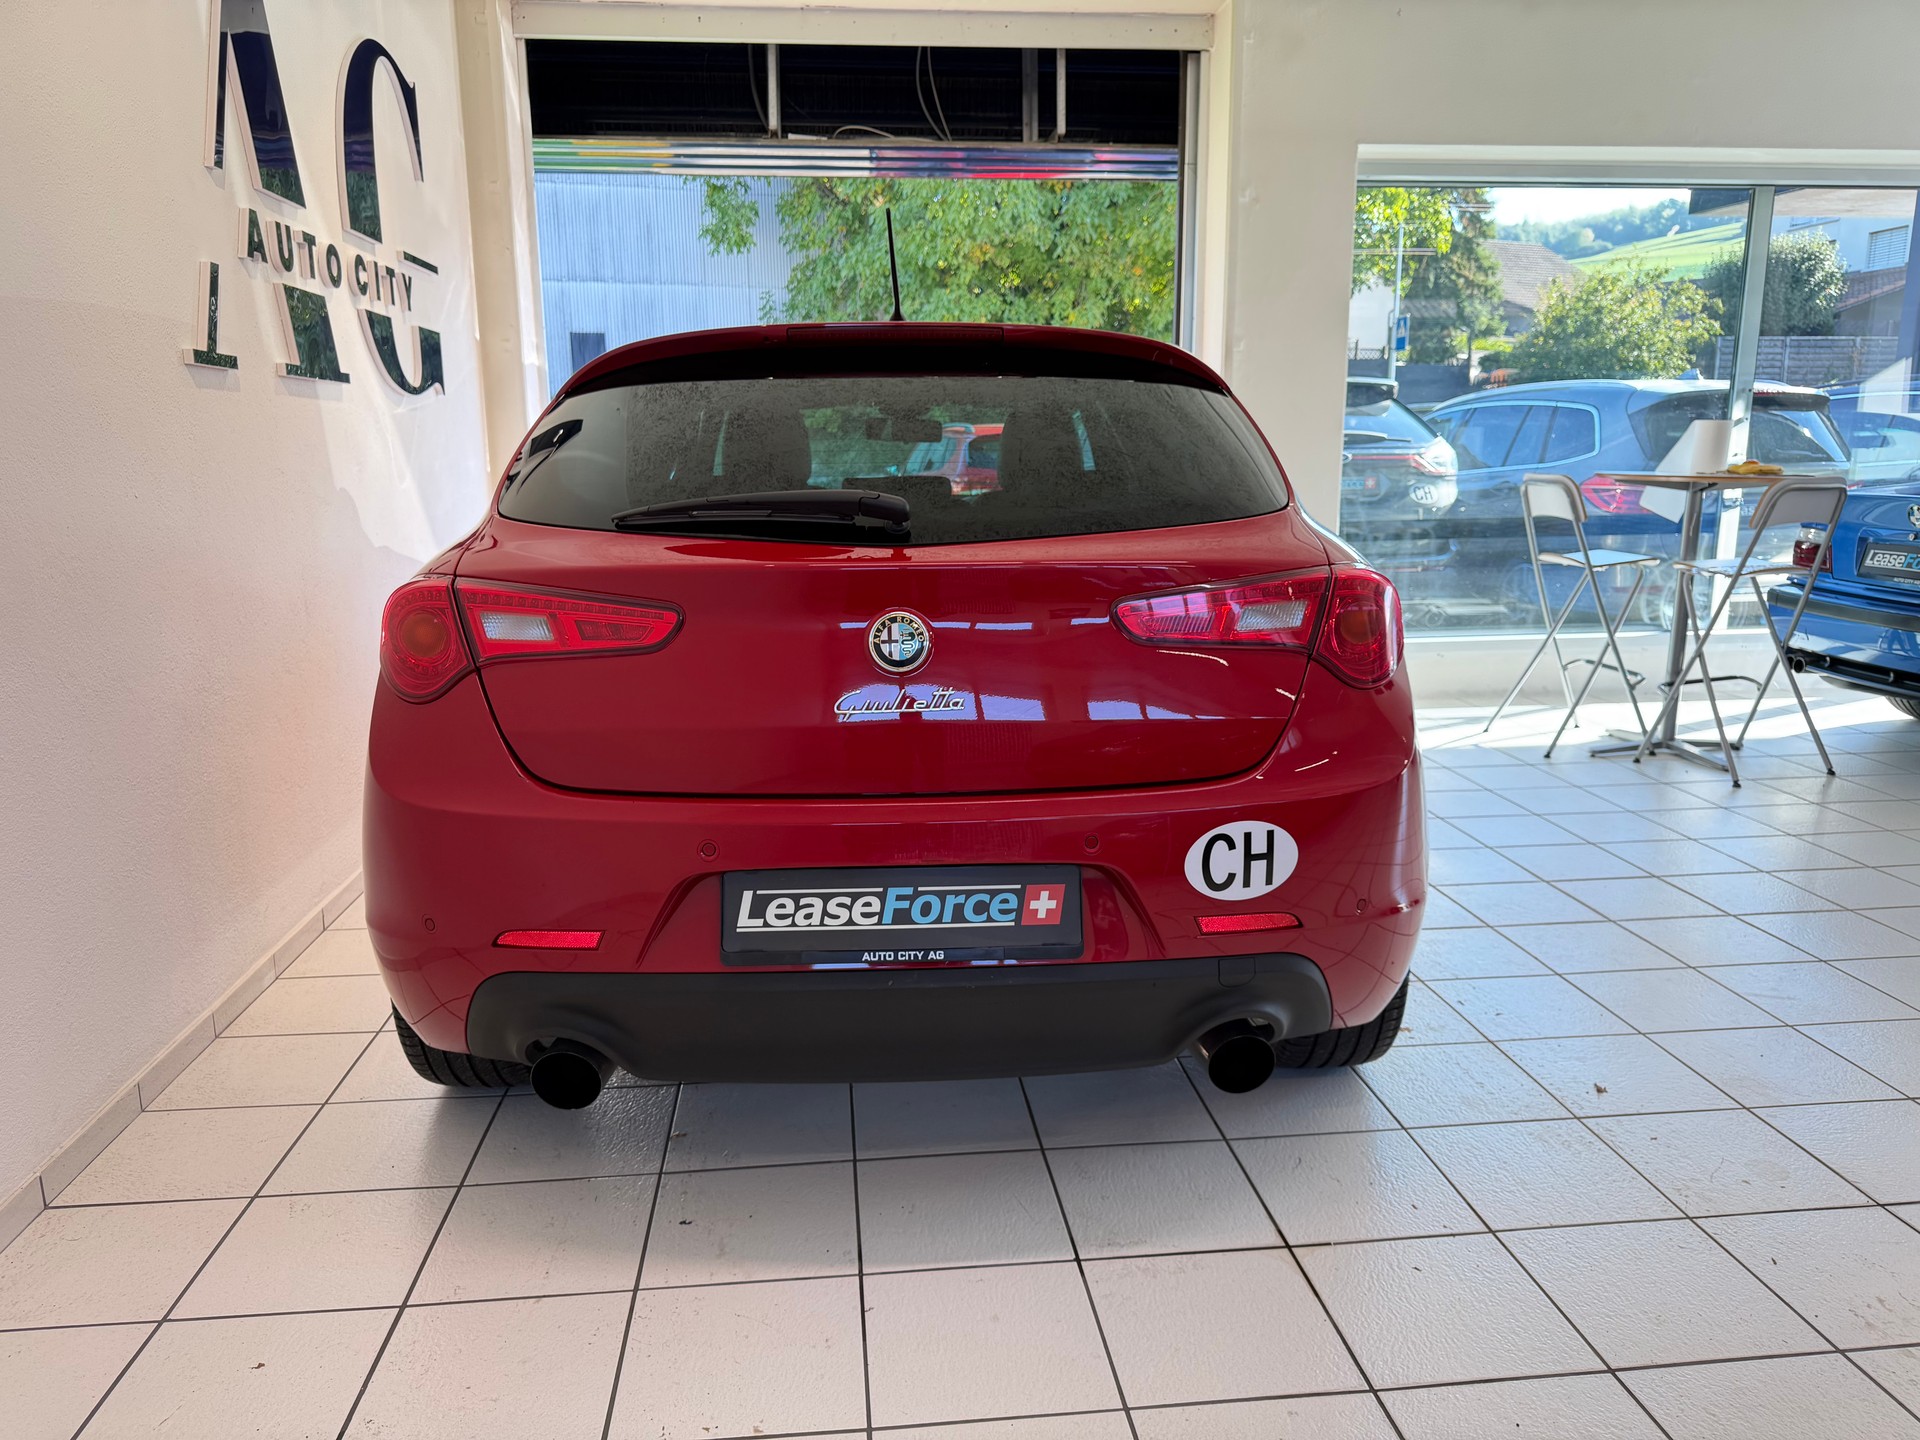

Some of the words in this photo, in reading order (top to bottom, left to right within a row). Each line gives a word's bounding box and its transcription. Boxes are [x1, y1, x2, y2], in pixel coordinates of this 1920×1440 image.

[238, 207, 342, 289] AUTO
[347, 253, 413, 312] CITY
[1413, 485, 1433, 501] CH
[873, 619, 892, 644] ALFA
[896, 616, 925, 642] ROMEO
[834, 687, 965, 721] Giulietta
[1201, 829, 1275, 892] CH
[736, 886, 1018, 928] LeaseForce
[861, 951, 894, 962] AUTO
[897, 950, 925, 961] CITY
[927, 950, 944, 961] AG
